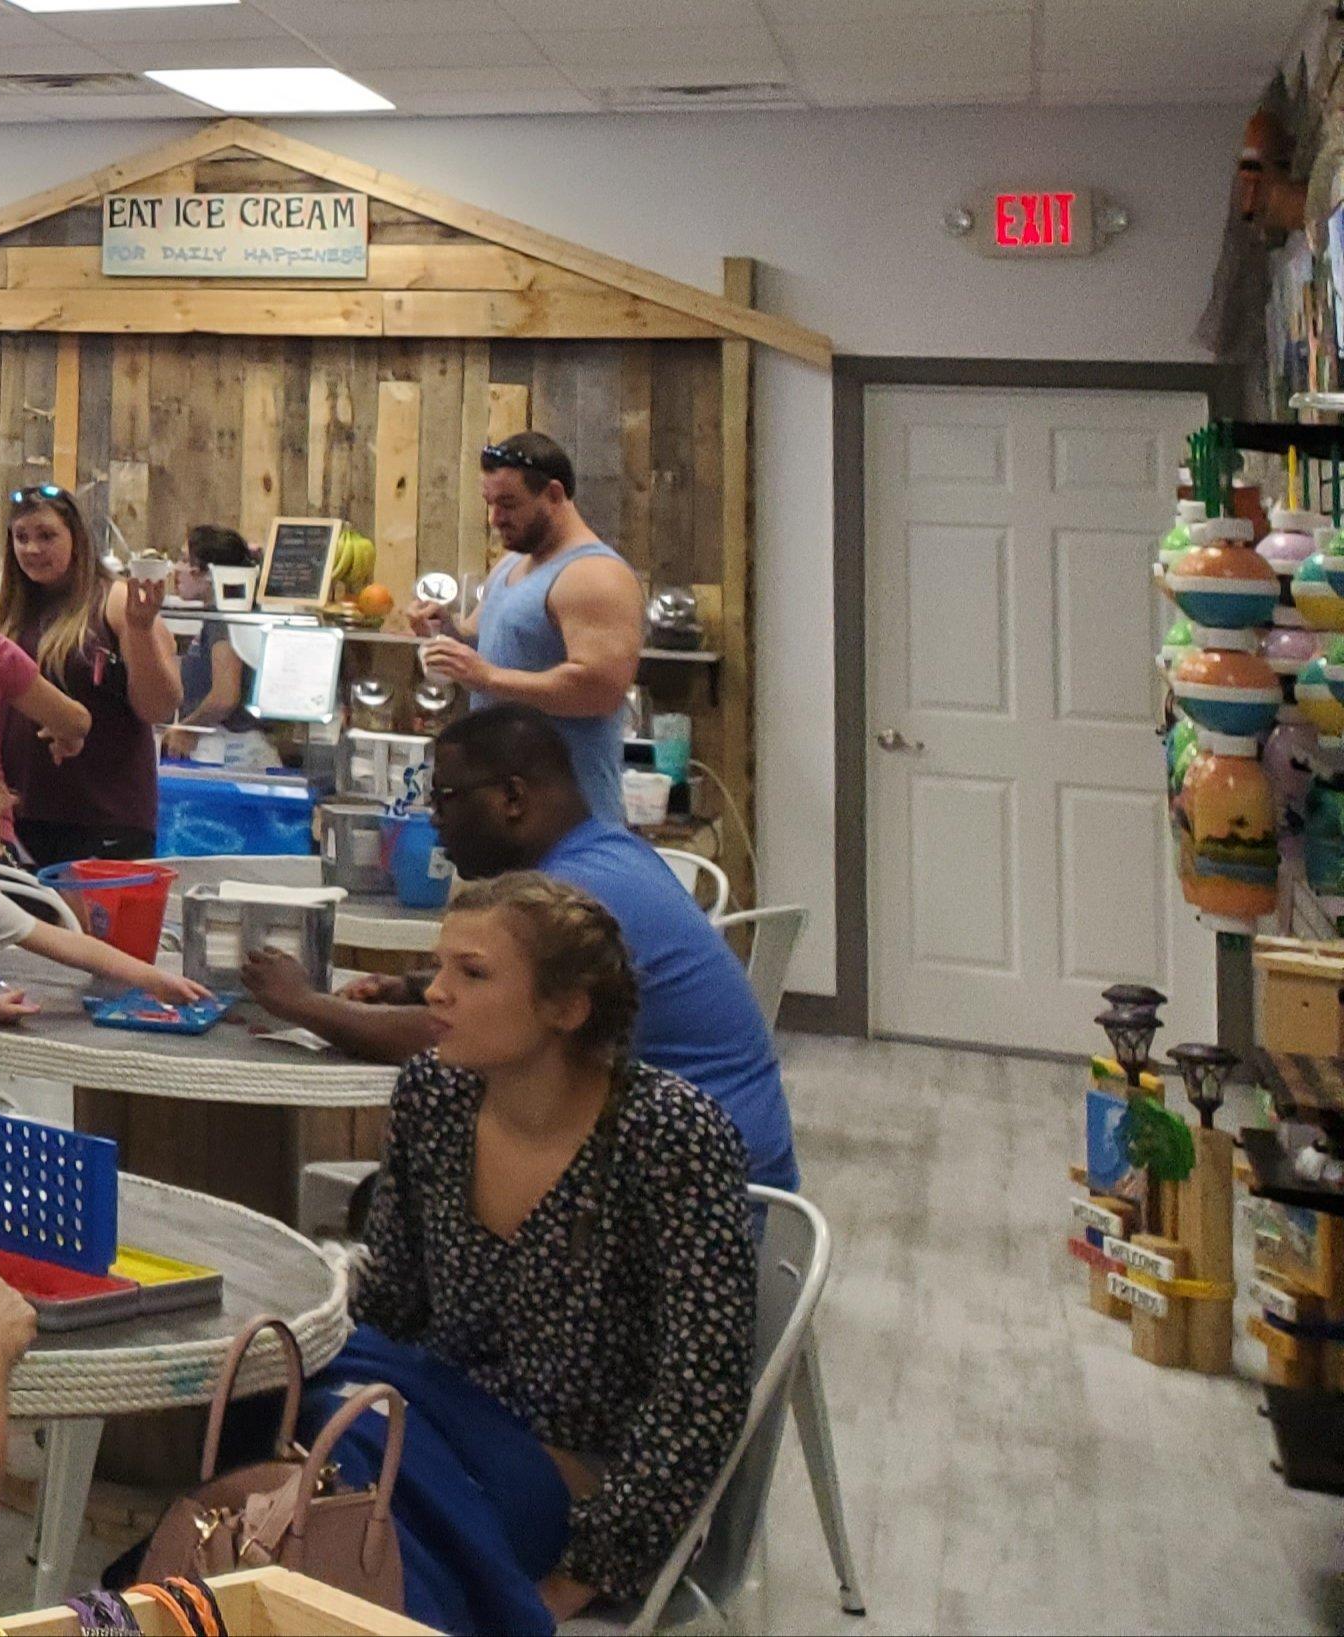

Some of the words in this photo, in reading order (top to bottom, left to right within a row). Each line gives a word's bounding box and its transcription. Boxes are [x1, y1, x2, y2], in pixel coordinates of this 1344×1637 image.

[109, 198, 162, 229] EAT
[175, 197, 225, 229] ICE
[240, 197, 355, 230] CREAM
[995, 193, 1075, 247] EXIT
[108, 245, 145, 262] FOR
[163, 245, 227, 262] DAILY
